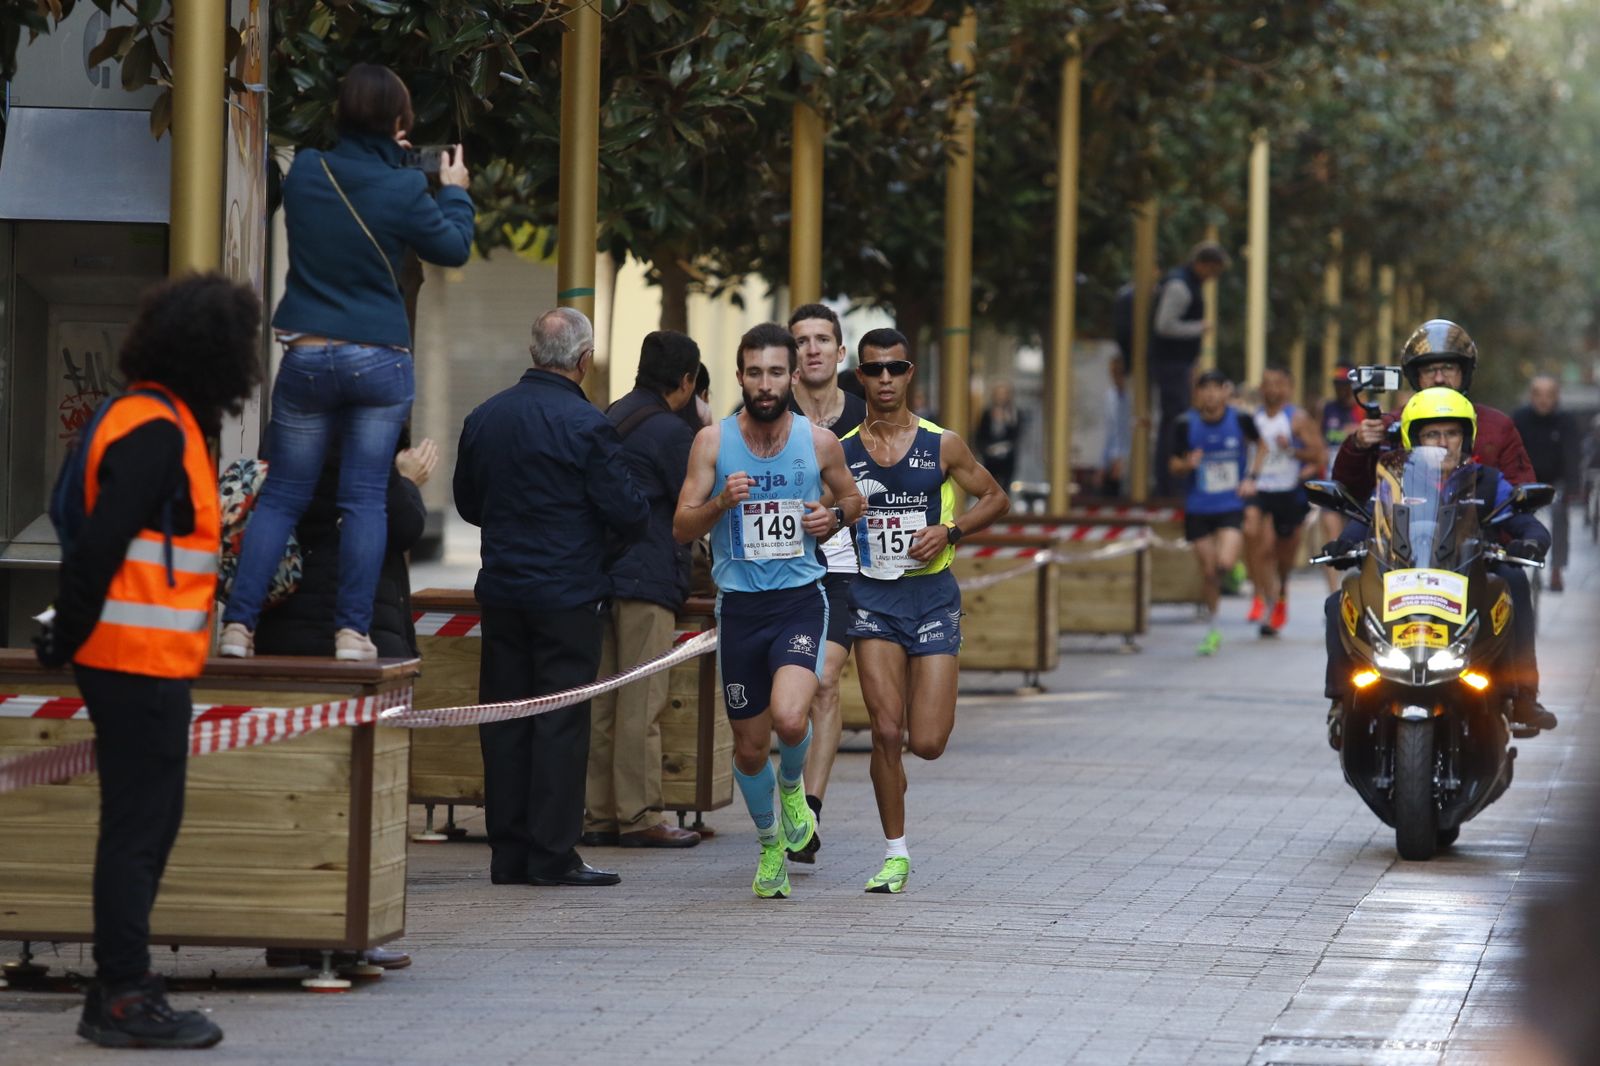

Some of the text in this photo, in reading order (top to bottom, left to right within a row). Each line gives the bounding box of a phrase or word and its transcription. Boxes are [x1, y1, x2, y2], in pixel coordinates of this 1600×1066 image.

[885, 491, 928, 505] Unicaja
[753, 515, 796, 541] 149
[876, 529, 917, 554] 157
